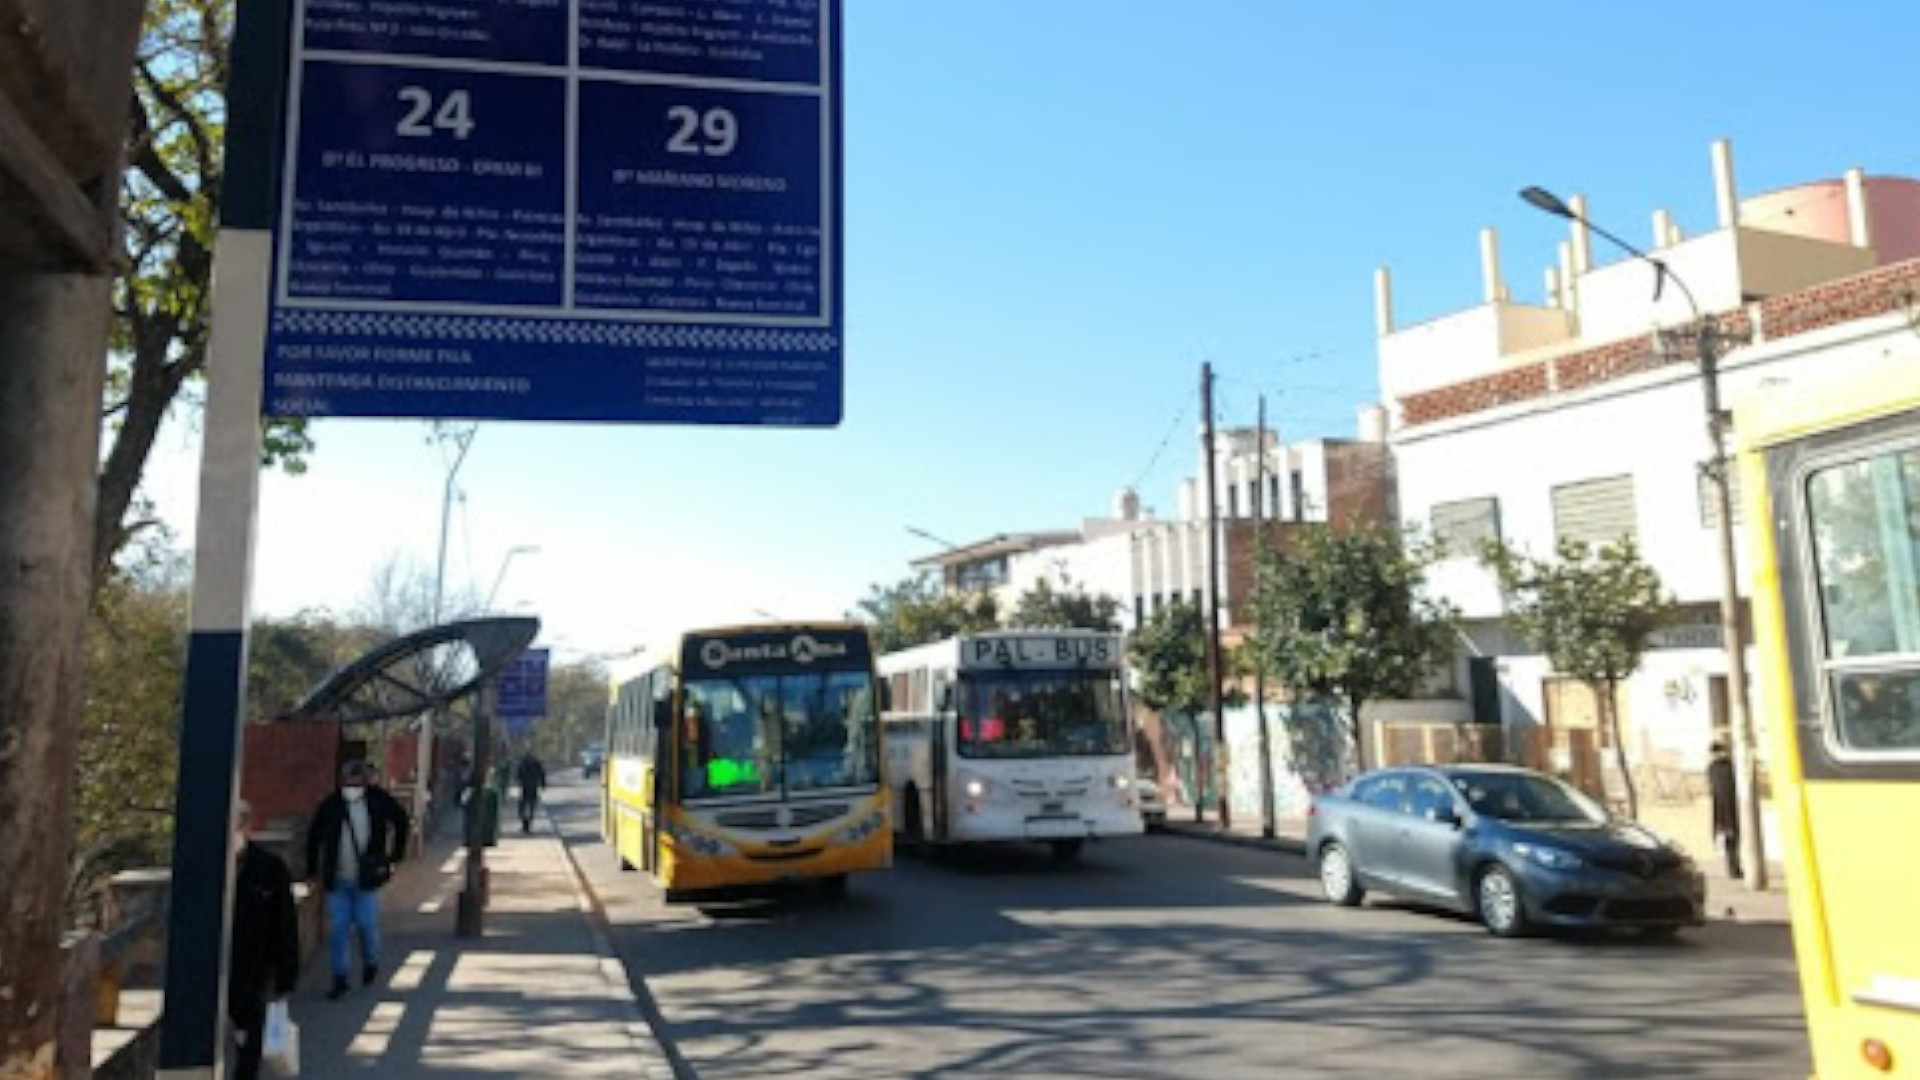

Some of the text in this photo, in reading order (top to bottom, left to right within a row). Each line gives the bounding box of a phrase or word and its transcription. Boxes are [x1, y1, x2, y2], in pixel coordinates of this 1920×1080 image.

[396, 85, 475, 140] 24
[665, 104, 739, 157] 29
[975, 639, 1033, 661] PAL
[1055, 639, 1109, 661] BUS
